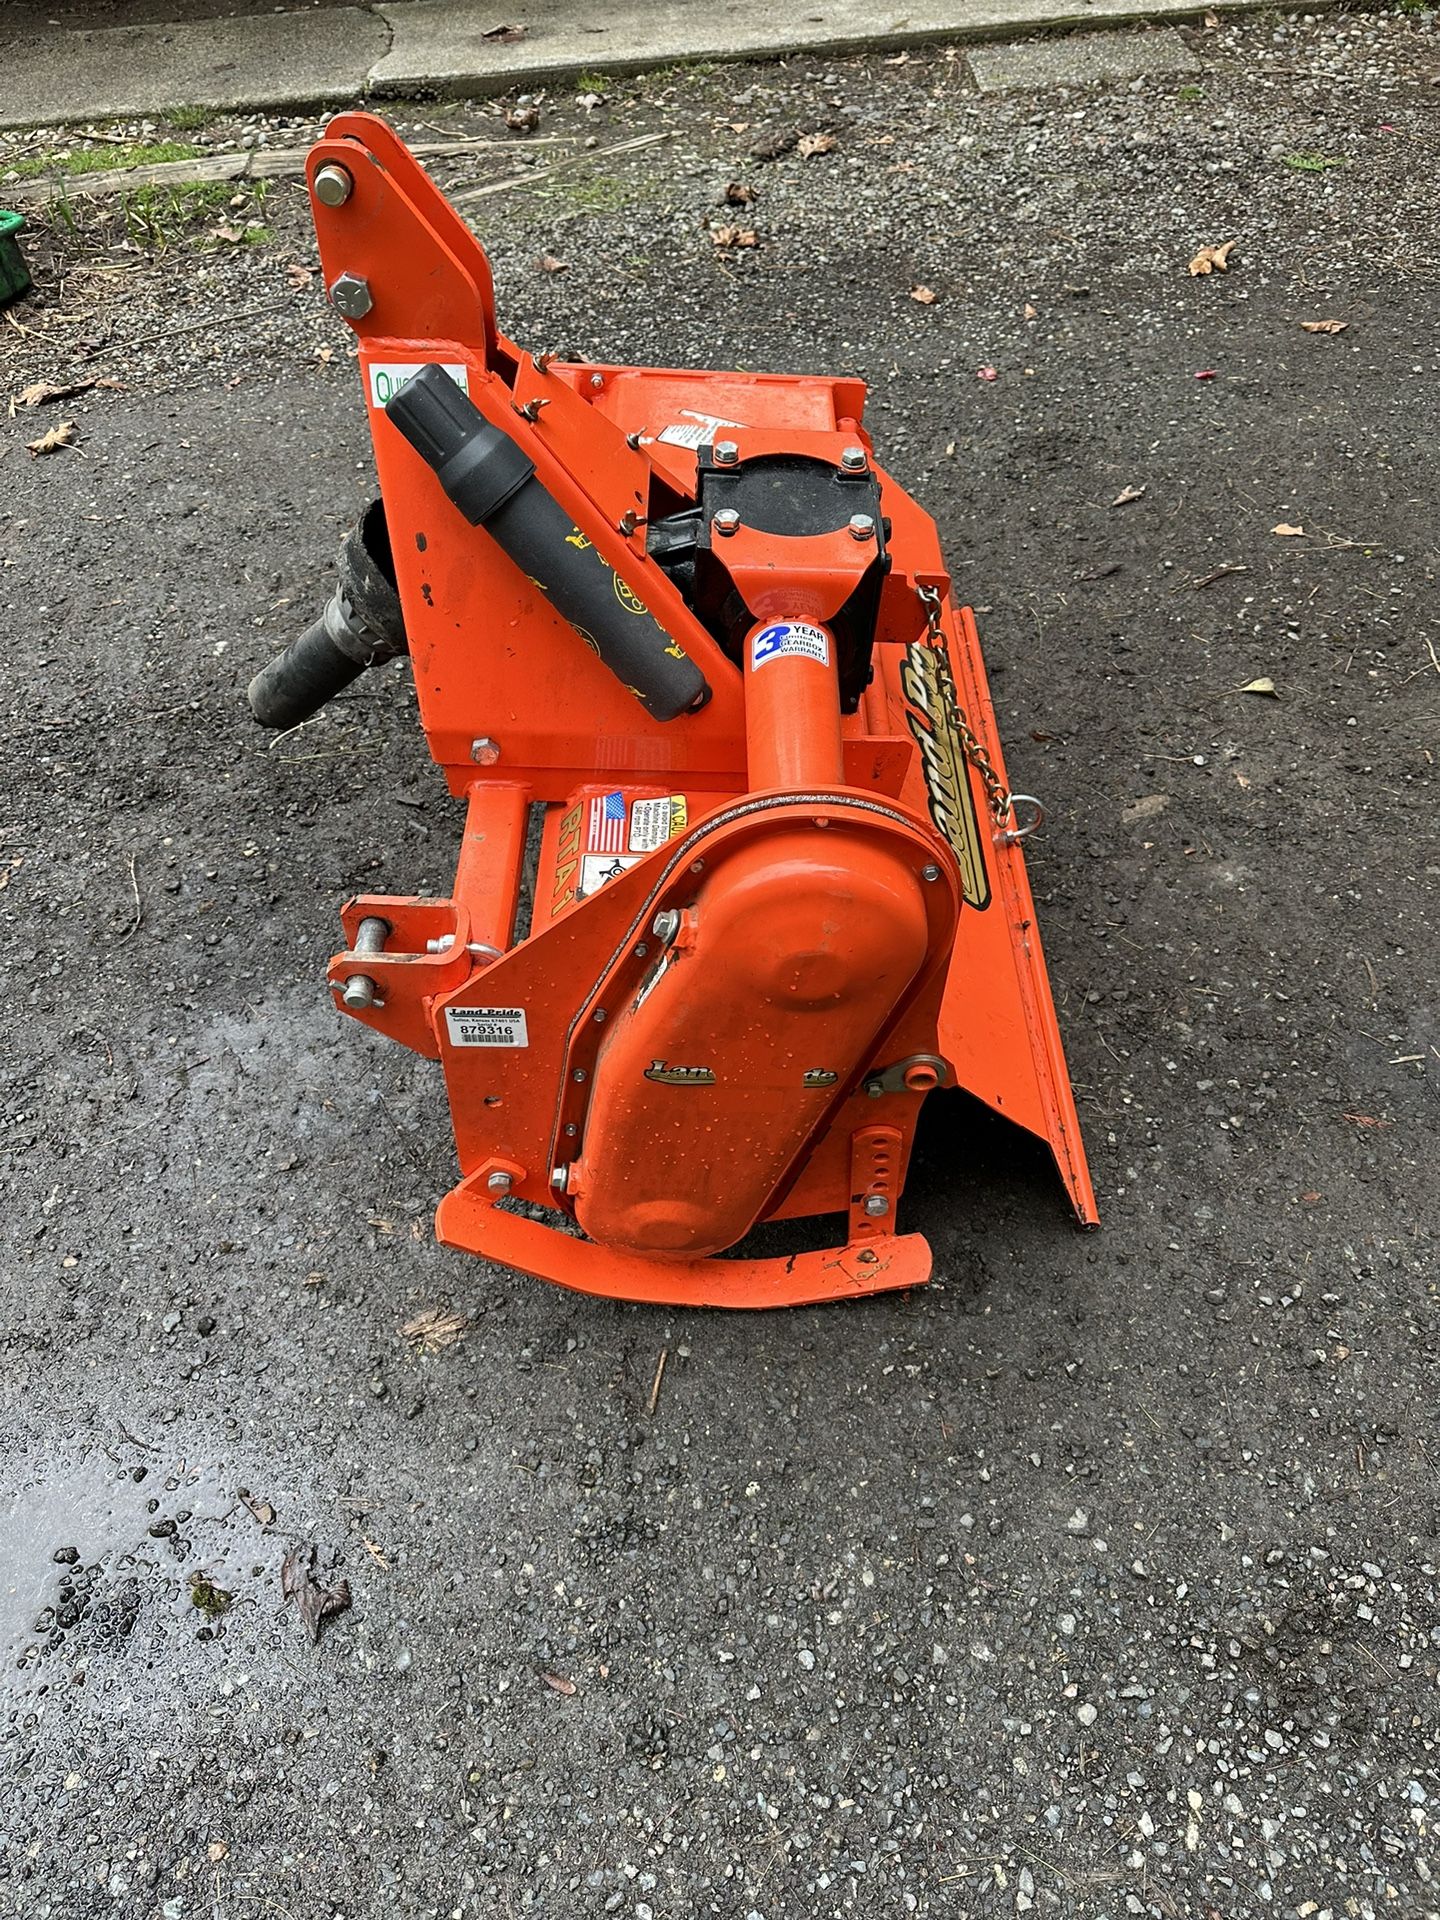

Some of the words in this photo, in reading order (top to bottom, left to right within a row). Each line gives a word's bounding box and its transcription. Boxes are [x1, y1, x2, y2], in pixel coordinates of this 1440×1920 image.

[755, 626, 791, 660] 3
[794, 625, 824, 642] YEAR
[780, 640, 823, 653] GEARBOX
[780, 646, 826, 660] WARRANTY
[652, 802, 661, 824] Machine
[450, 1008, 483, 1016] Land
[487, 1008, 521, 1017] Pride
[460, 1026, 513, 1034] 879316
